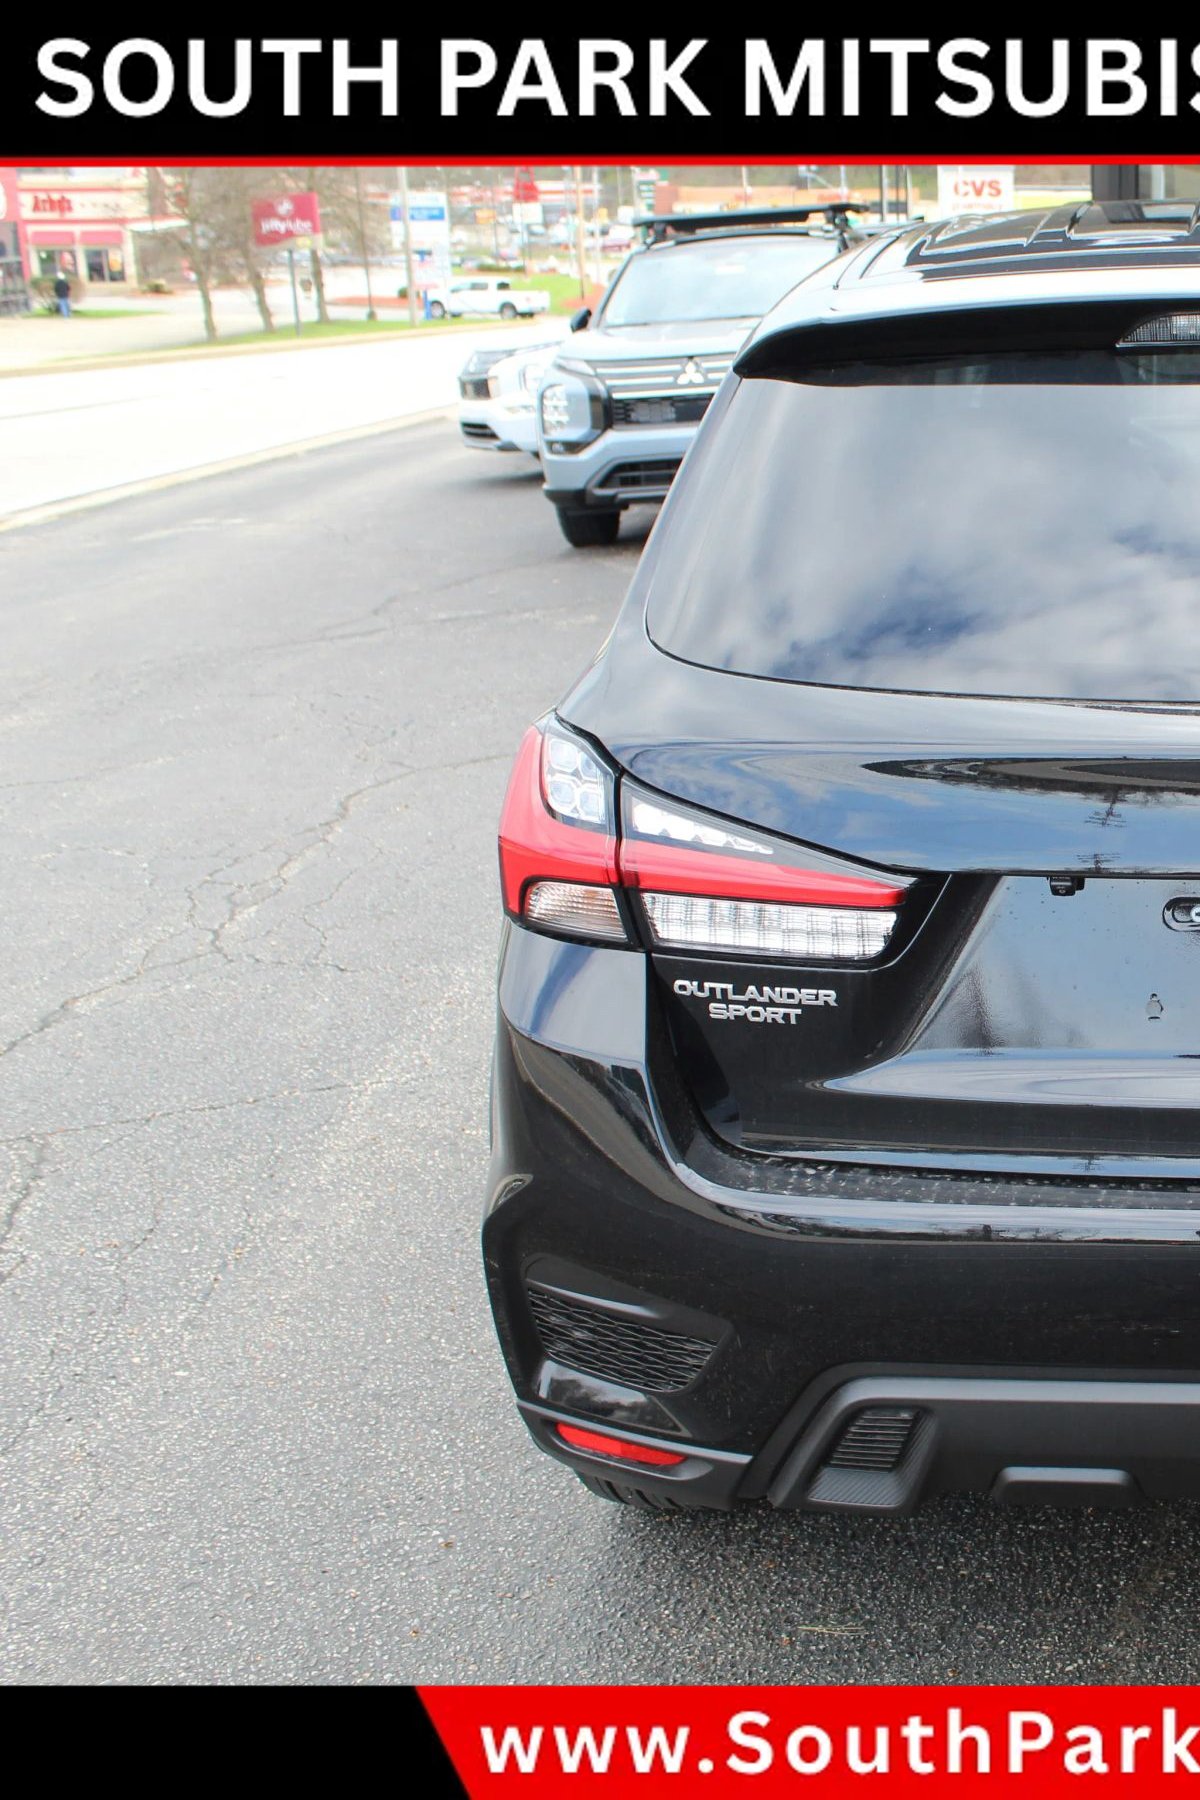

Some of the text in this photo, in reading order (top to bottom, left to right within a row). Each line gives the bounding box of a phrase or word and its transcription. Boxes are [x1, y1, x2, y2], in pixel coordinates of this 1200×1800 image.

[953, 179, 1002, 197] CVS
[673, 979, 838, 1007] OUTLANDER
[708, 1003, 802, 1024] SPORT
